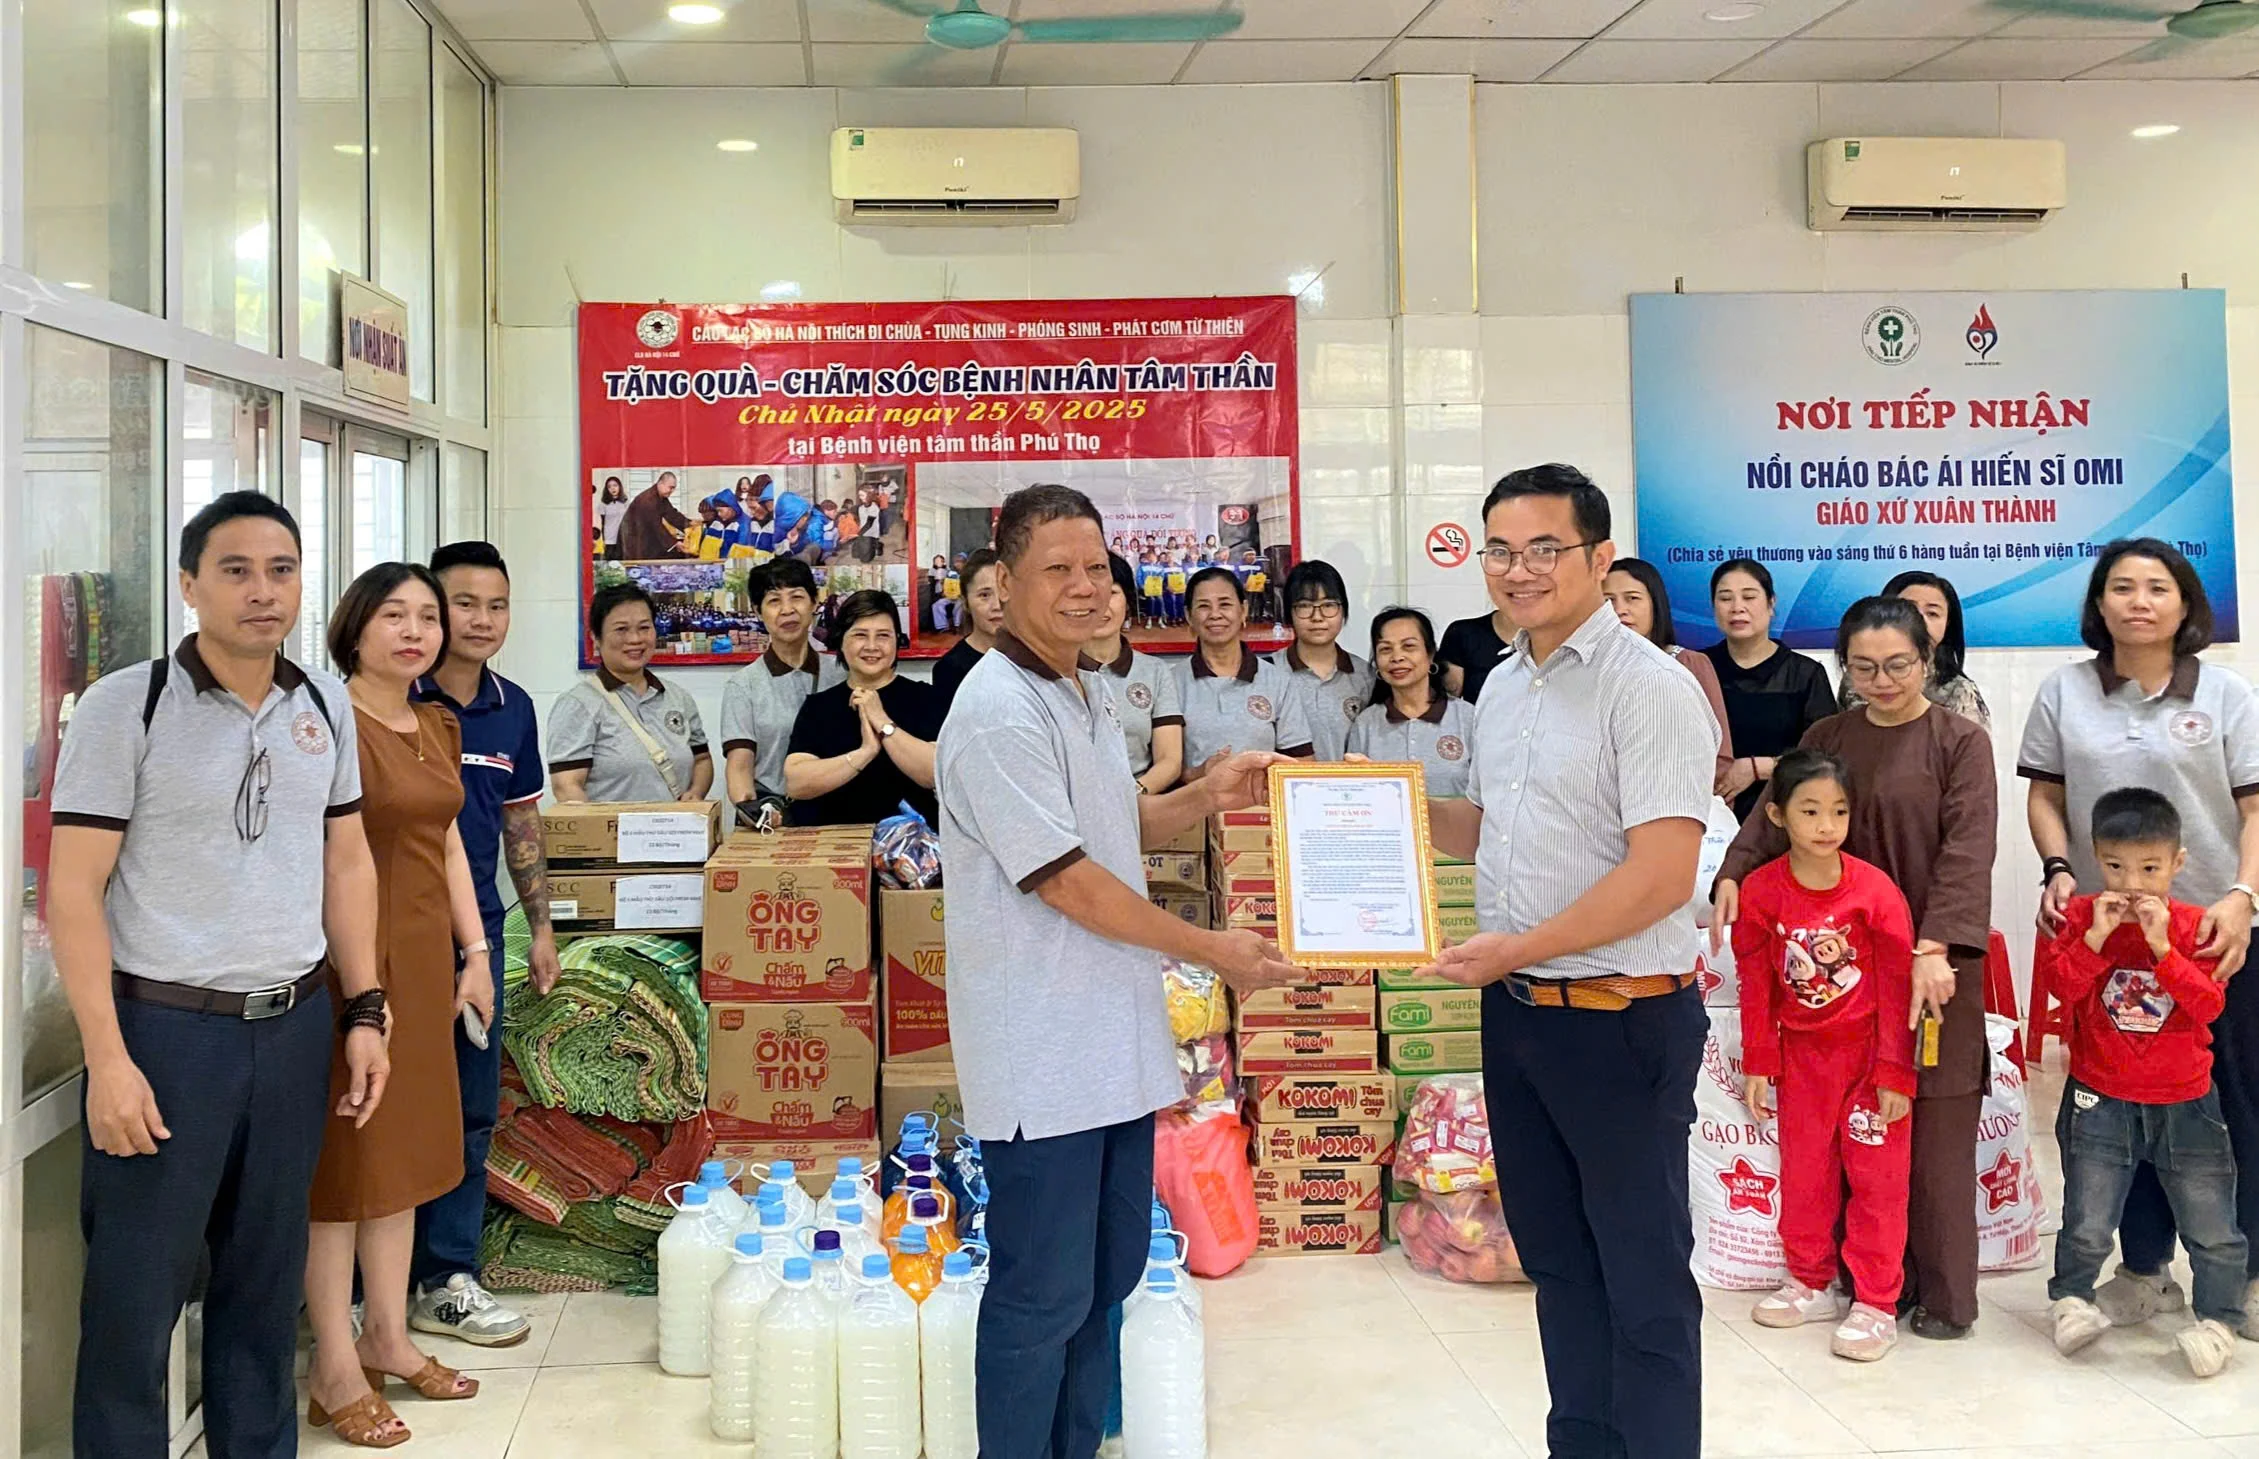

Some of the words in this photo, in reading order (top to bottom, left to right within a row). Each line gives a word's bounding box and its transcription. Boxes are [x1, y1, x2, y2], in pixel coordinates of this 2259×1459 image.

[775, 323, 795, 340] HÀ
[798, 323, 822, 343] NỘI
[825, 322, 866, 340] THÍCH
[868, 325, 882, 340] ĐI
[886, 321, 923, 340] CHÙA
[935, 323, 970, 342] TỤNG
[973, 322, 1007, 339] KINH
[1018, 319, 1066, 338] PHÓNG
[1068, 321, 1102, 337] SINH
[1113, 318, 1150, 336] PHÁT
[1151, 320, 1185, 336] CƠM
[1186, 317, 1206, 336] TỪ
[1206, 315, 1244, 337] THIỆN
[604, 364, 689, 405] TẶNG
[693, 361, 761, 404] QUÀ
[782, 362, 872, 396] CHĂM
[876, 360, 938, 396] SÓC
[942, 360, 1024, 400] BỆNH
[1030, 358, 1119, 391] NHÂN
[1123, 356, 1186, 390] TÂM
[1193, 351, 1277, 390] THẦN
[738, 403, 798, 425] Chủ
[803, 403, 877, 427] Nhật
[883, 403, 961, 427] ngày
[966, 399, 1147, 425] 25/5/2025
[1776, 396, 1851, 430] NƠI
[1863, 387, 1956, 429] TIẾP
[1968, 391, 2091, 435] NHẬN
[788, 437, 815, 456] tại
[821, 435, 872, 456] Bệnh
[877, 435, 921, 456] viện
[925, 434, 965, 452] tâm
[970, 430, 1015, 453] thần
[1020, 431, 1059, 452] Phú
[1064, 432, 1100, 455] Thọ
[1747, 453, 1791, 489] NỒI
[1800, 456, 1869, 489] CHÁO
[1878, 455, 1928, 487] BÁC
[1937, 454, 1962, 487] ÁI
[1971, 450, 2031, 486] HIẾN
[2040, 454, 2065, 486] SĨ
[2074, 458, 2123, 485] OMI
[1816, 497, 1869, 525] GIÁO
[1877, 496, 1908, 525] XỨ
[1914, 496, 1975, 524] XUÂN
[1982, 494, 2056, 523] THÀNH
[1667, 546, 1704, 563] (Chia
[1708, 544, 1724, 562] sẻ
[1728, 545, 1753, 561] yêu
[1756, 546, 1804, 563] thương
[1807, 545, 1832, 560] vào
[1836, 544, 1869, 562] sáng
[1873, 543, 1895, 560] thứ
[1899, 545, 1907, 559] 6
[1912, 544, 1945, 561] hàng
[1950, 541, 1979, 559] tuần
[1984, 544, 2001, 562] tại
[2005, 542, 2040, 561] Bệnh
[2044, 543, 2073, 561] viện
[748, 891, 820, 925] ÔNG
[748, 924, 820, 951] TÂY
[765, 961, 804, 975] Chấm
[1283, 991, 1333, 1006] KOKOMI
[896, 1010, 927, 1021] 100%
[1390, 1005, 1431, 1022] Fami
[754, 1028, 829, 1064] ÔNG
[1284, 1036, 1334, 1050] KOKOMI
[754, 1064, 828, 1091] TÂY
[1277, 1087, 1355, 1108] KOKOMI
[1360, 1085, 1383, 1095] Tôm
[772, 1099, 812, 1114] Chấm
[1360, 1096, 1385, 1106] chua
[1364, 1107, 1382, 1117] cay
[1270, 1138, 1294, 1148] chua
[1273, 1128, 1291, 1137] cay
[1702, 1120, 1739, 1149] GẠO
[1272, 1149, 1294, 1159] Tôm
[1297, 1135, 1377, 1157] KOKOMI
[1284, 1180, 1362, 1200] KOKOMI
[1285, 1224, 1363, 1245] KOKOMI
